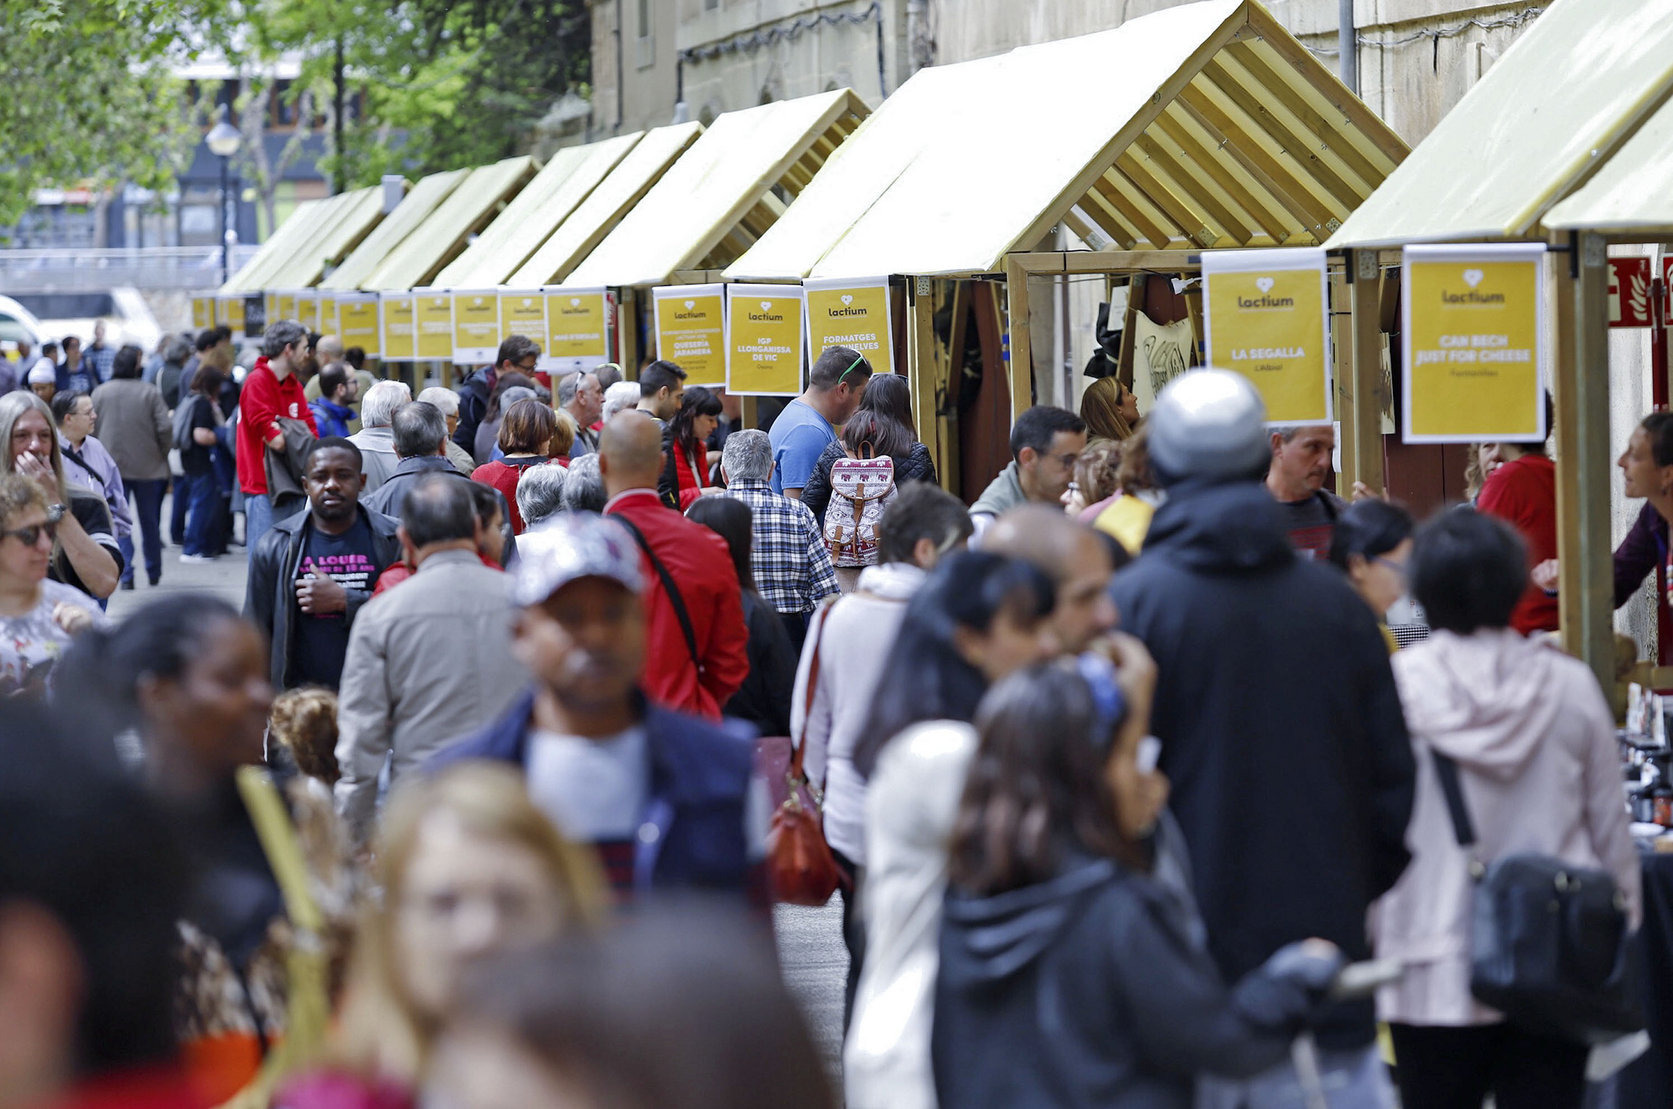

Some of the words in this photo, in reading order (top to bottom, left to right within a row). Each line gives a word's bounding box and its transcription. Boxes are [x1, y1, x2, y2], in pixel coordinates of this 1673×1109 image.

[1238, 295, 1294, 308] lactium
[1441, 289, 1505, 303] lactium
[674, 312, 706, 320] lactium
[748, 312, 783, 321] lactium
[828, 306, 867, 317] lactium
[823, 333, 876, 344] FORMATGES
[1439, 334, 1469, 348] CAN
[1470, 334, 1509, 348] BECH
[737, 345, 791, 354] LLONGANISSA
[1231, 348, 1248, 361] LA
[1249, 346, 1305, 359] SEGALLA
[1415, 349, 1448, 367] JUST
[1448, 349, 1477, 363] FOR
[1478, 348, 1531, 363] CHEESE
